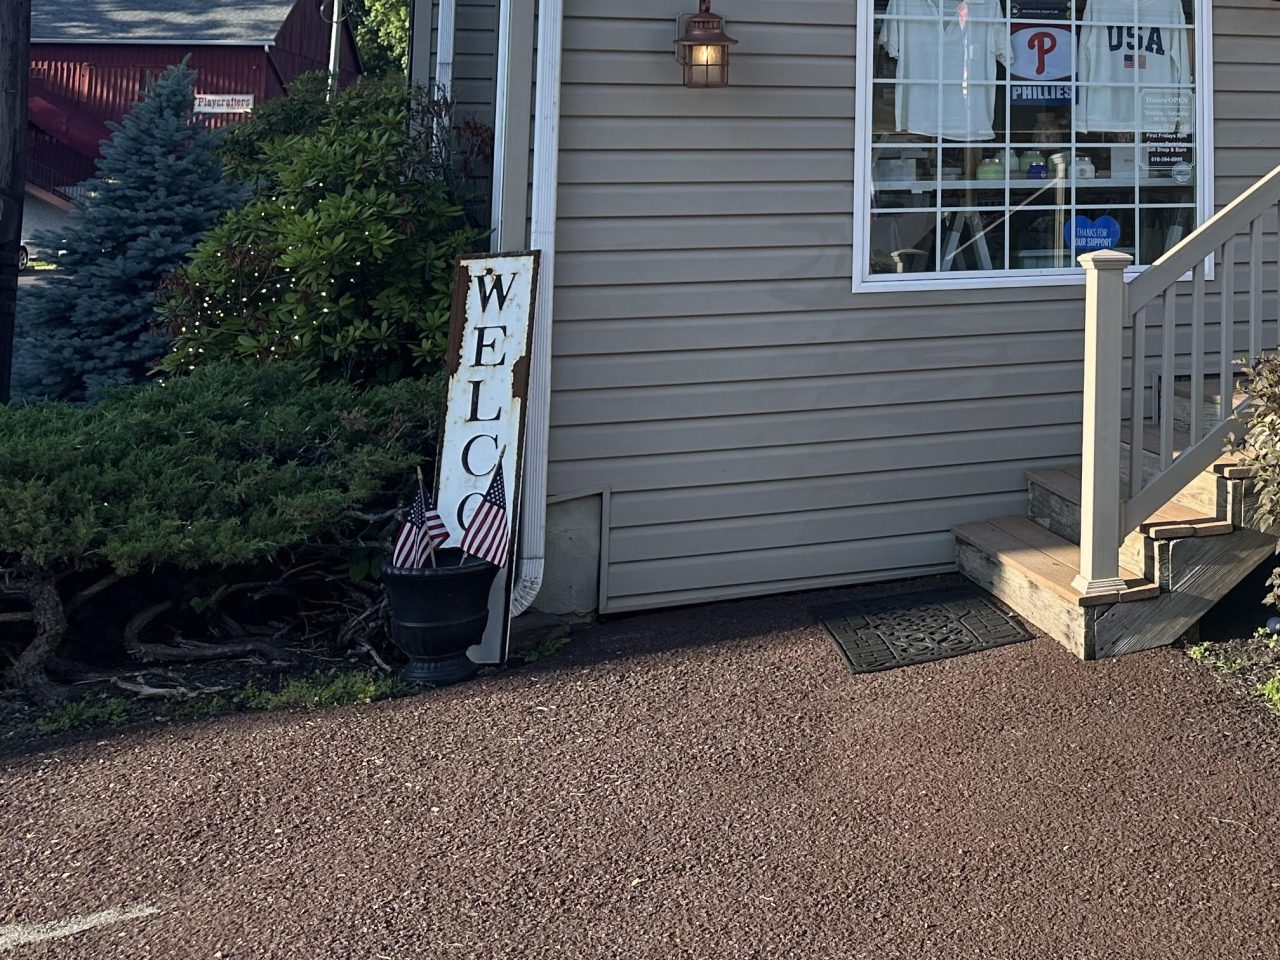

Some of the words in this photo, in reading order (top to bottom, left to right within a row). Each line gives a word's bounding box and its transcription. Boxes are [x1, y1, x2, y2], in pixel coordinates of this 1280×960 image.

[1106, 25, 1166, 56] USA
[1012, 86, 1072, 100] PHILLIES
[198, 97, 250, 108] Playcrafters
[1076, 228, 1097, 237] THANKS
[1098, 228, 1108, 237] FOR
[1087, 238, 1112, 247] SUPPORT
